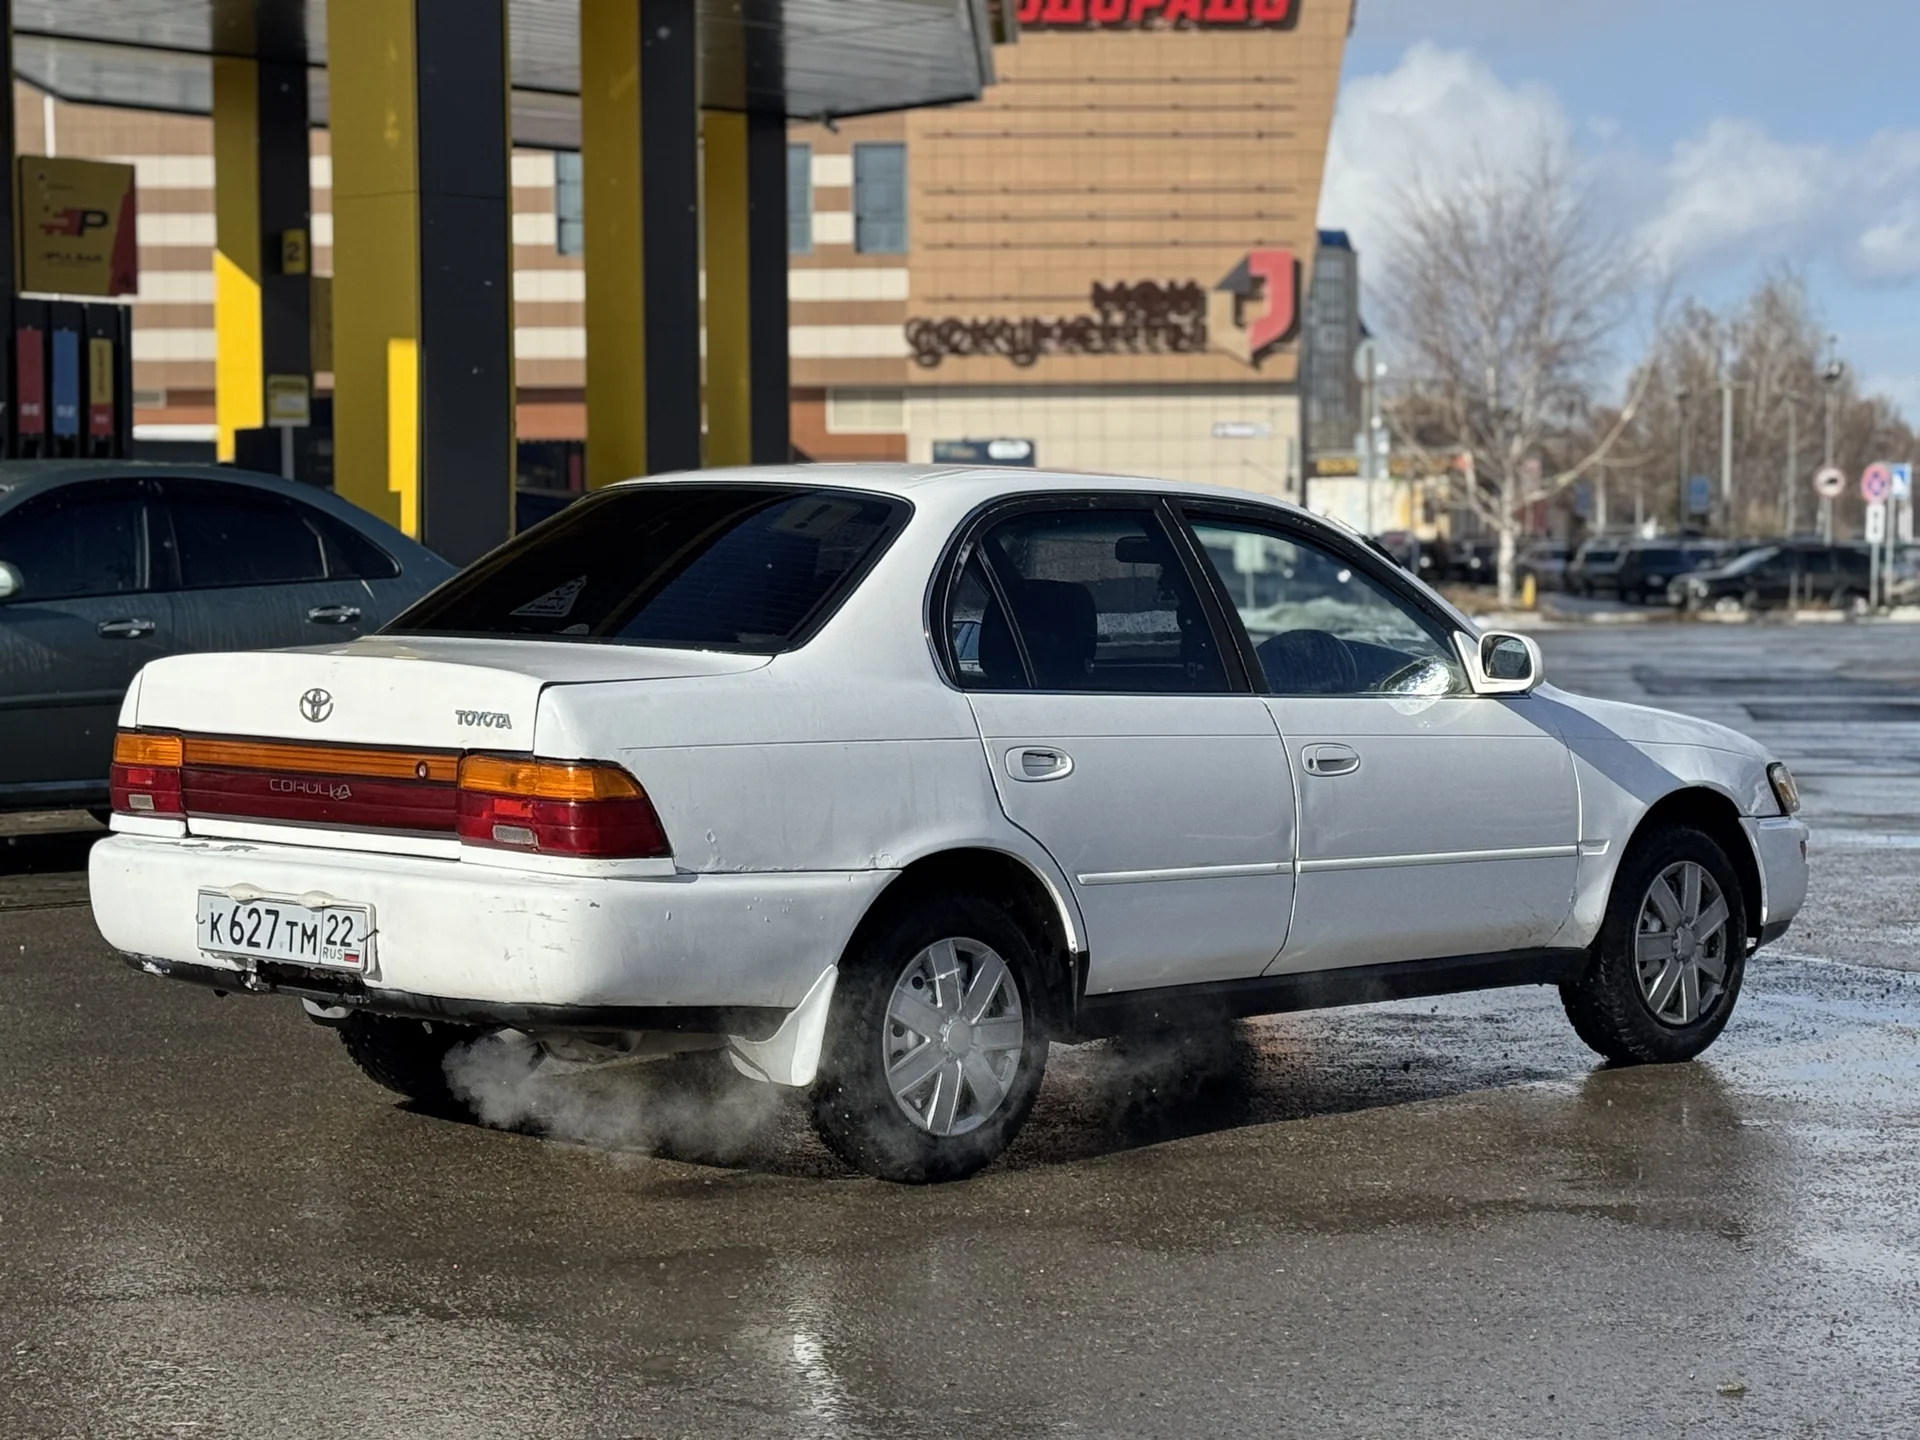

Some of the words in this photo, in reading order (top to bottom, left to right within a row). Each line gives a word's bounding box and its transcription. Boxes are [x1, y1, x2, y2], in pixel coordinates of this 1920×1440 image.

[1016, 0, 1288, 23] ДОРАДО
[287, 242, 302, 262] 2
[455, 709, 513, 730] TOYOTA
[325, 913, 354, 948] 22
[322, 946, 343, 961] RUS
